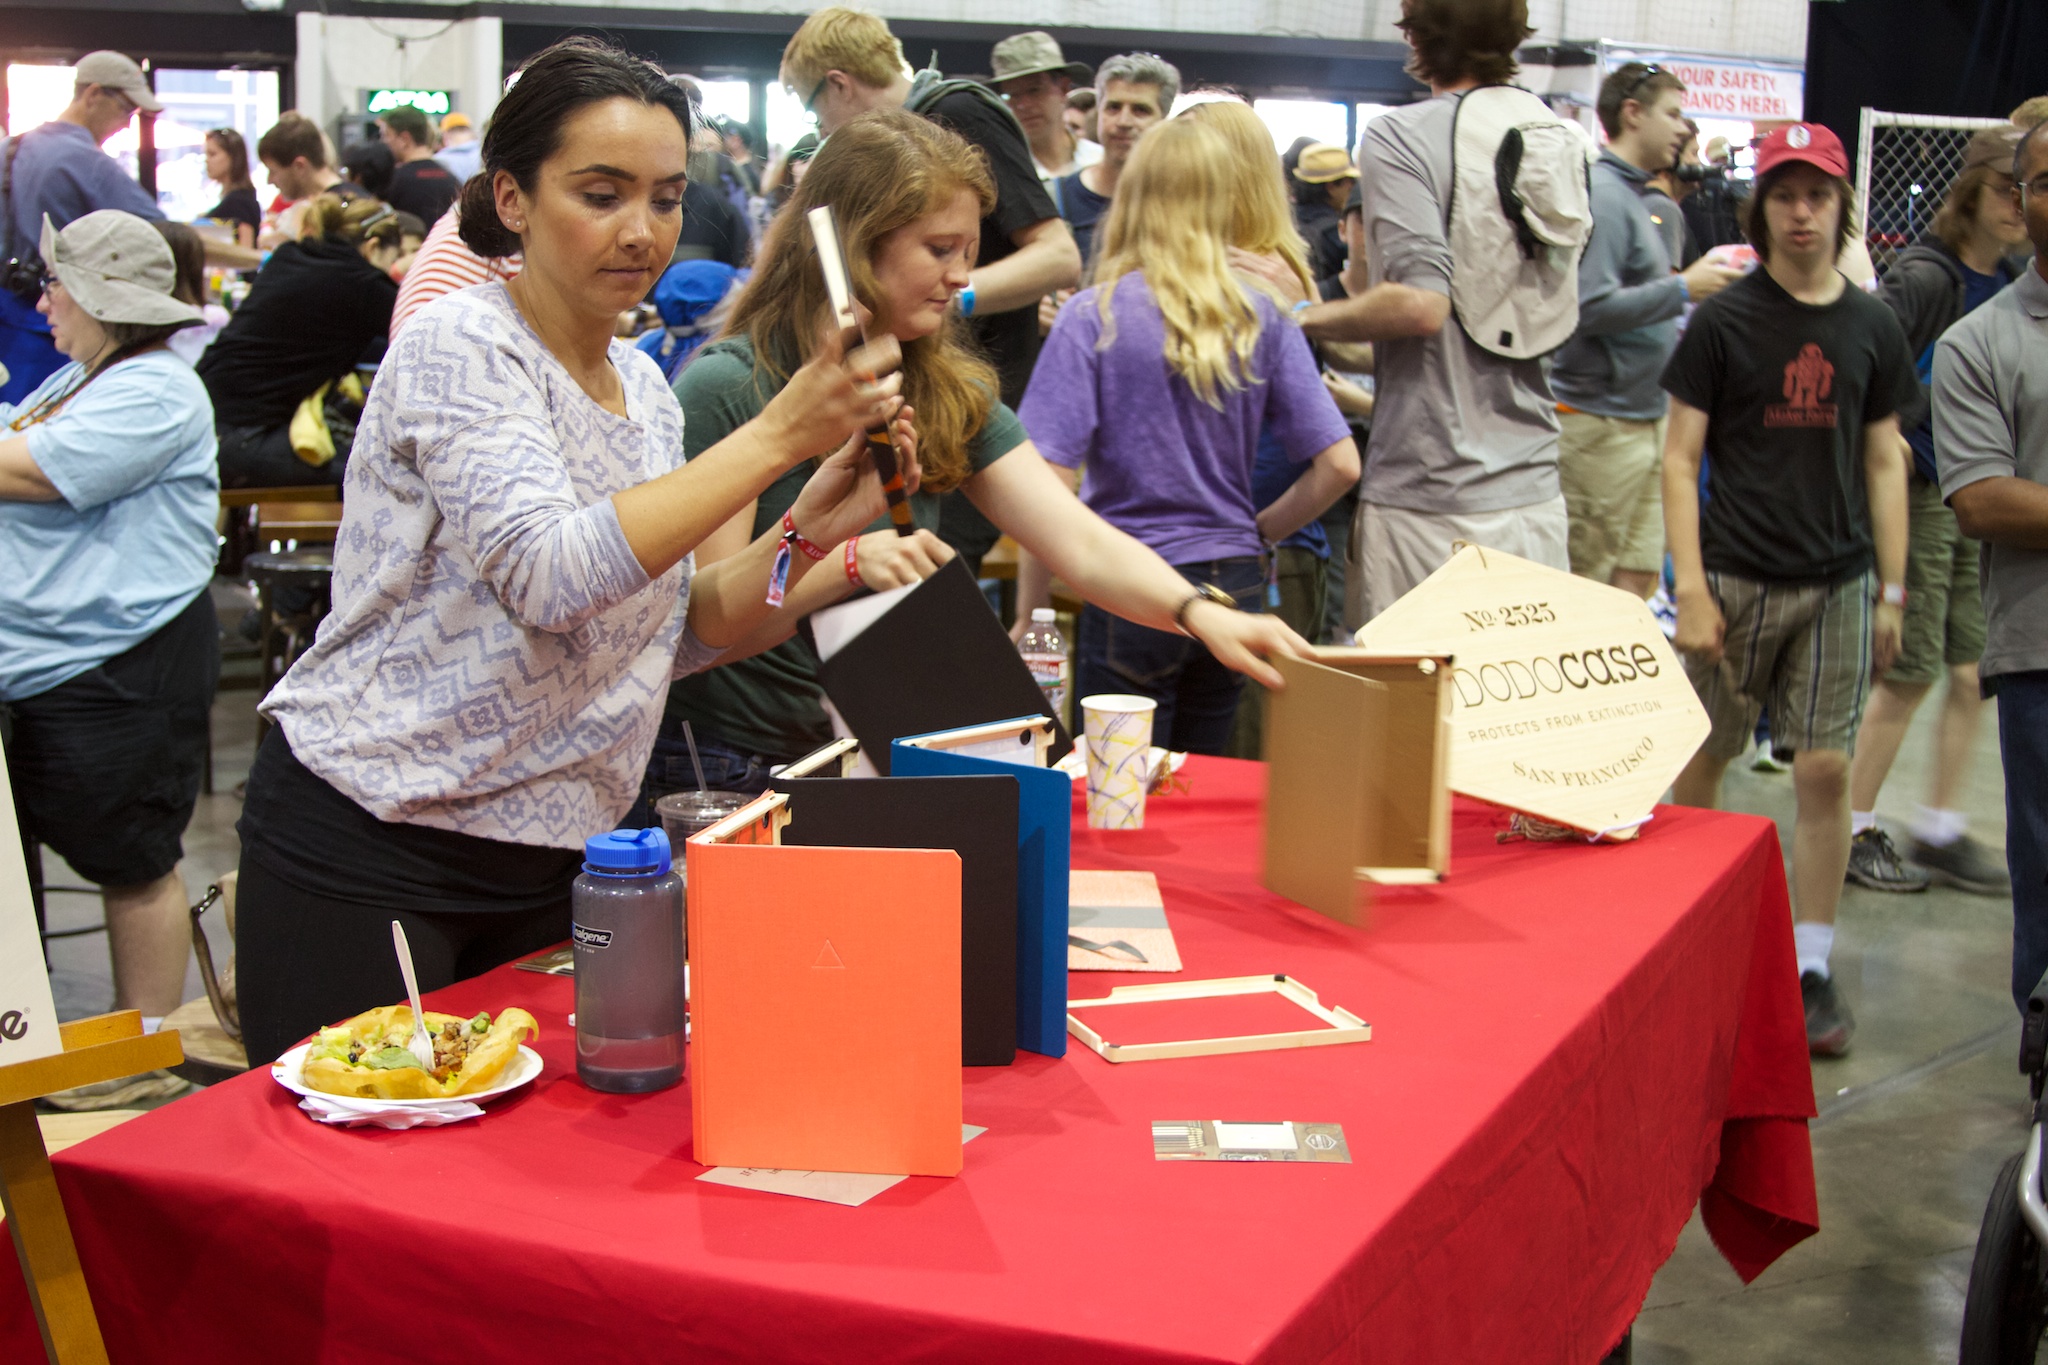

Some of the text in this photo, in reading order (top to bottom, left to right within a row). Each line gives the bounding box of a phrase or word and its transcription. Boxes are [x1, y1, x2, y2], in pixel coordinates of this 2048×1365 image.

[1671, 65, 1776, 91] YOUR SAFETY
[1499, 602, 1556, 627] 2525
[1452, 643, 1659, 707] DODOcase
[1467, 699, 1662, 742] PROTECTS FROM EXTINCTION
[1512, 736, 1655, 787] SAN FRANCISCO
